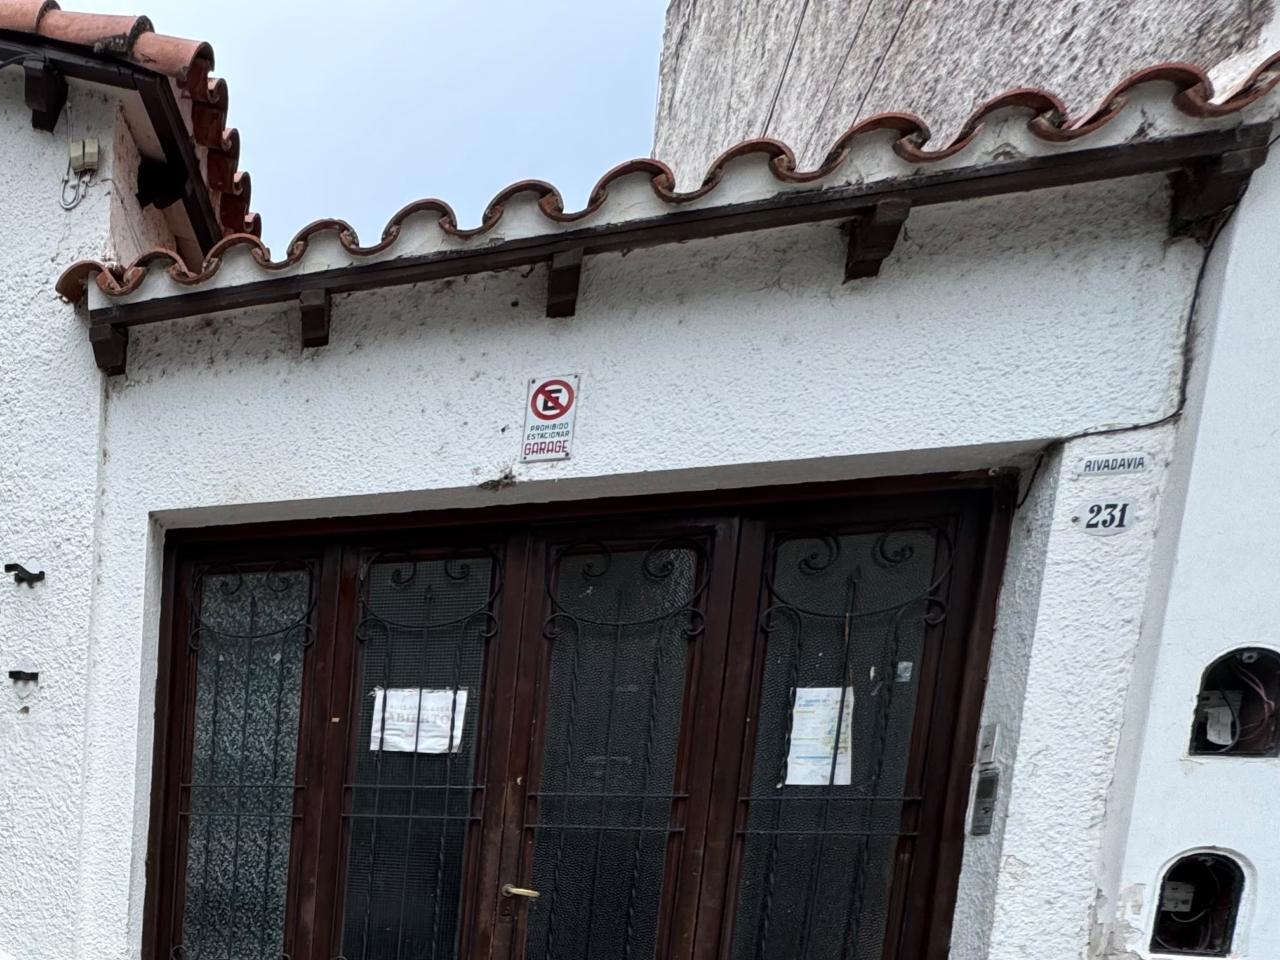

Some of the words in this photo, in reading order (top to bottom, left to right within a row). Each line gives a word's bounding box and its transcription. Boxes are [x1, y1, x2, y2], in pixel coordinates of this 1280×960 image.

[530, 422, 569, 432] PROHIBIDO
[526, 431, 571, 441] ESTACIONAR
[524, 440, 569, 456] GARAGE
[1083, 456, 1145, 472] RIVADAVIA
[1085, 503, 1130, 529] 231
